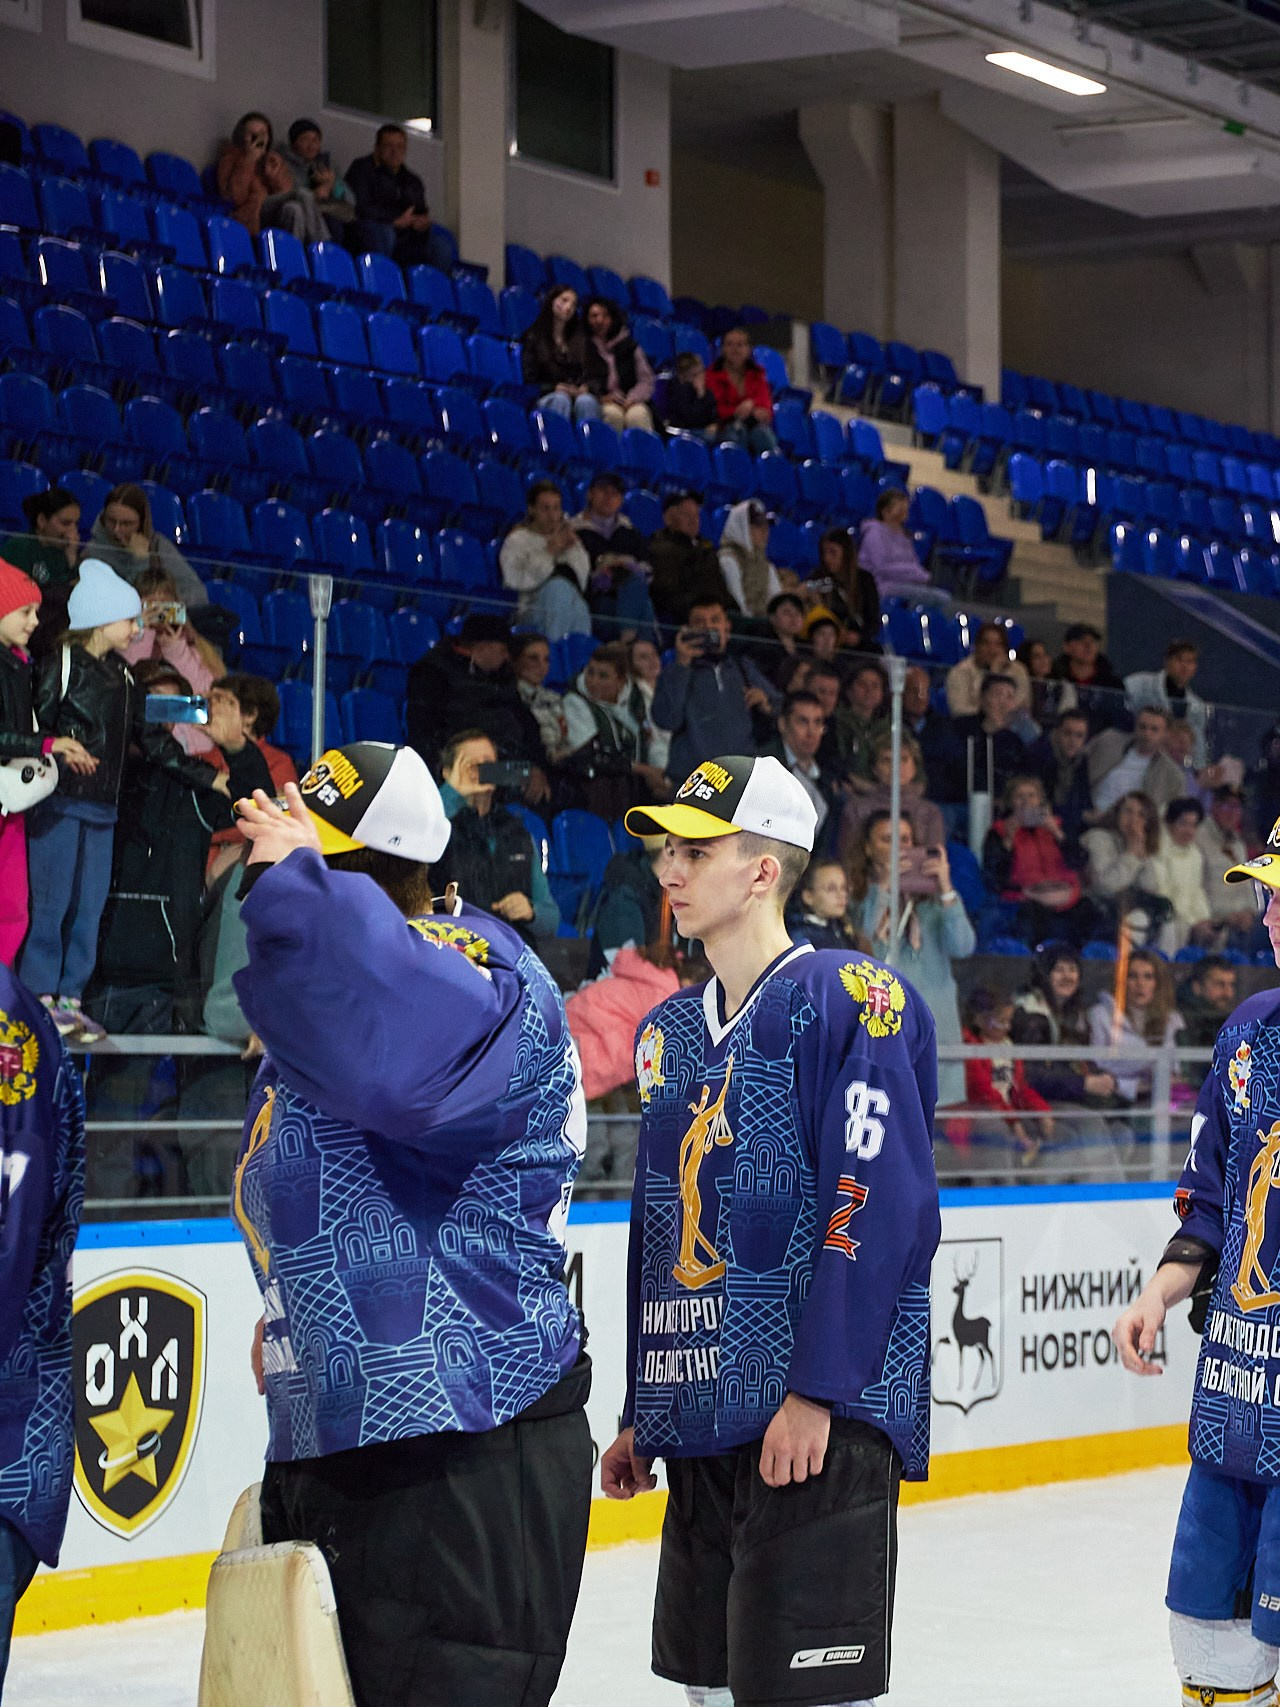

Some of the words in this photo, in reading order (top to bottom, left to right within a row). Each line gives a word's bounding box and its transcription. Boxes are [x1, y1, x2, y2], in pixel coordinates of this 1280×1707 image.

[317, 784, 340, 807] 25
[694, 784, 715, 801] 25
[844, 1080, 890, 1162] 86
[1021, 1257, 1143, 1313] НИЖНИЙ
[642, 1296, 723, 1335] НИЖЕГОРО
